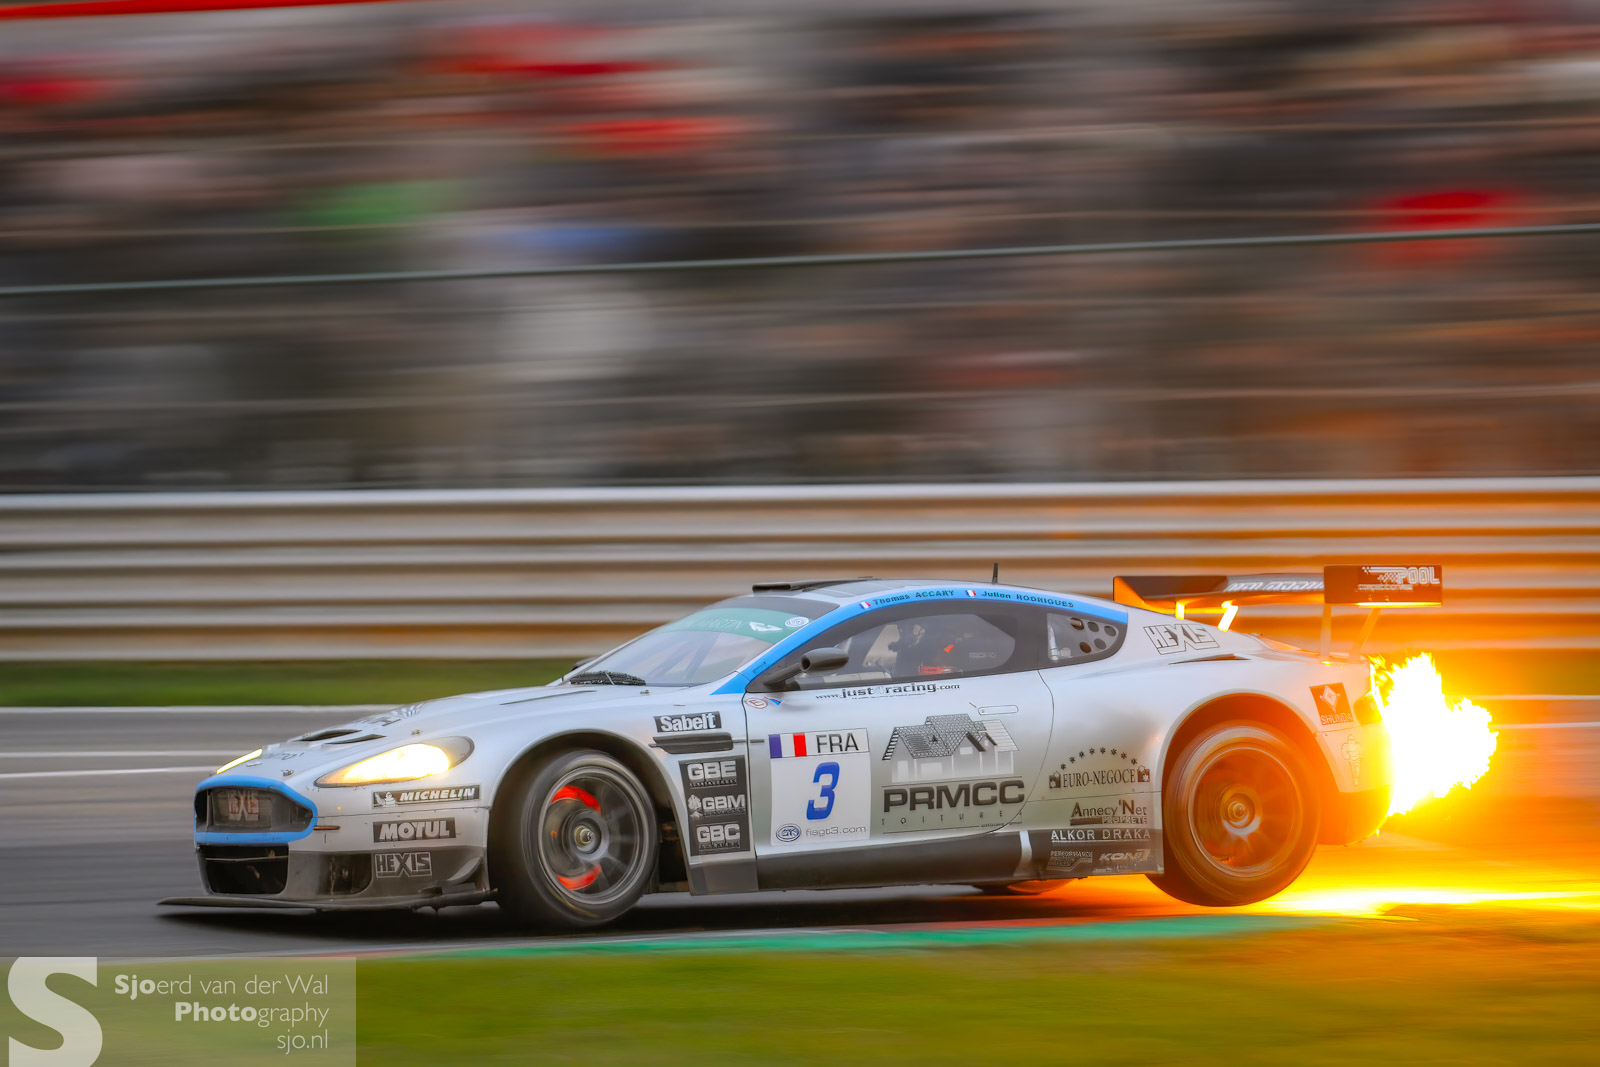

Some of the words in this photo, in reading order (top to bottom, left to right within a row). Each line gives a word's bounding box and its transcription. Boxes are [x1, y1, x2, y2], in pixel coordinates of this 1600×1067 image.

[1397, 566, 1440, 585] POOL
[873, 593, 911, 606] Thomas
[915, 589, 955, 598] ACCARY
[981, 590, 1011, 599] Julien
[1016, 593, 1075, 608] RODRIGUES
[1143, 624, 1220, 655] HEXIS
[659, 712, 717, 732] Sabelt
[816, 732, 860, 753] FRA
[687, 760, 737, 781] GBE
[1062, 768, 1136, 788] EURO-NEGOCE
[399, 787, 476, 801] MICHELIN
[806, 761, 840, 820] 3
[883, 779, 1025, 813] PRMCC
[702, 794, 745, 810] GBM
[379, 820, 450, 840] MOTUL
[696, 823, 740, 843] GBC
[805, 825, 867, 838] fiagt3.com
[1051, 829, 1096, 841] ALKOR
[1102, 828, 1151, 840] DRAKA
[374, 851, 432, 878] HEXIS
